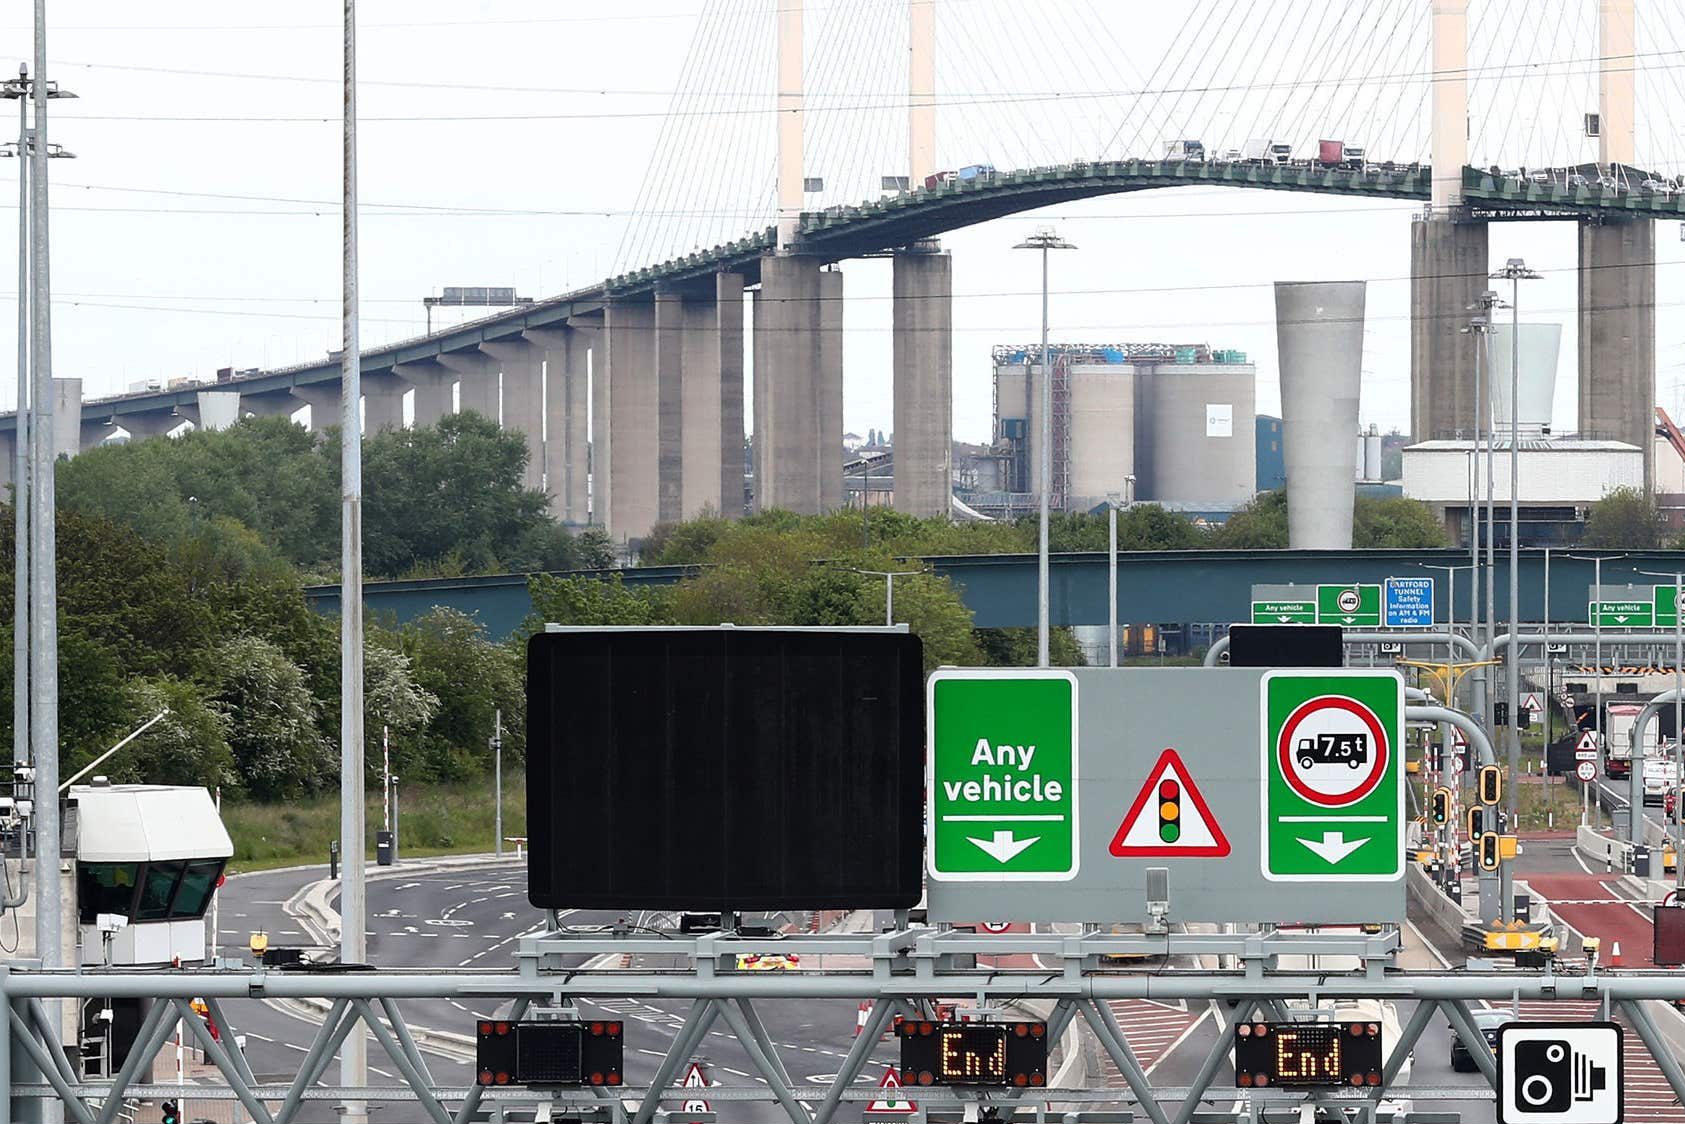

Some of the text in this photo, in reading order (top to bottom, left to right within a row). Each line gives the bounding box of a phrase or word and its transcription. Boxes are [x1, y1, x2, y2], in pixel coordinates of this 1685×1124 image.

[1265, 604, 1303, 613] Any vehicle
[1603, 604, 1640, 613] Any vehicle
[971, 738, 1036, 771] Any
[943, 774, 1063, 803] vehicle
[942, 1032, 1004, 1077] End
[1277, 1033, 1340, 1076] End
